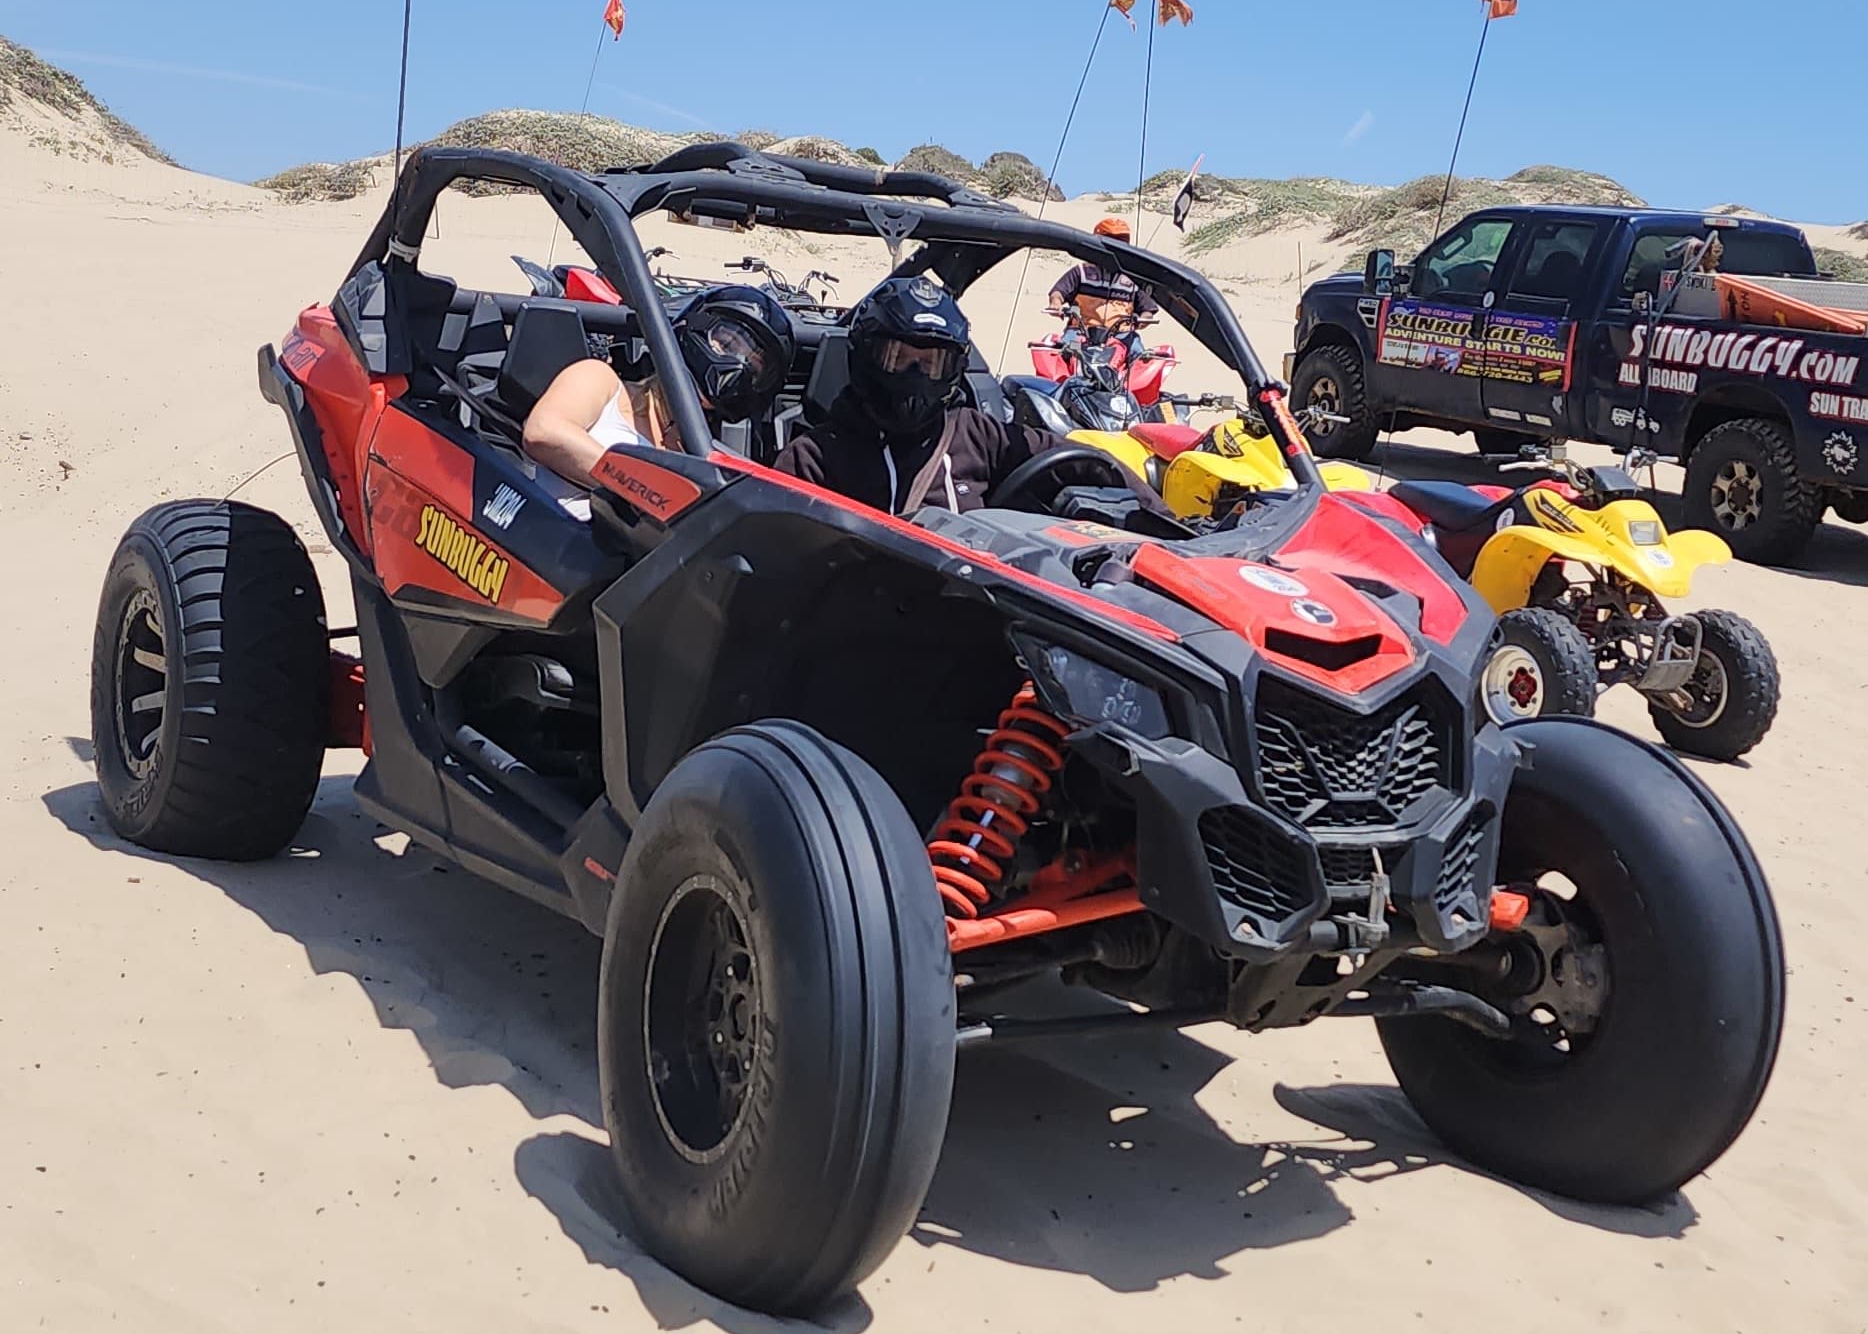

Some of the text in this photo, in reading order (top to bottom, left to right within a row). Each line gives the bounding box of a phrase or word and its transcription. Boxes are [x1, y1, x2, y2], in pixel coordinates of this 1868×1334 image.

[1384, 327, 1462, 348] ADVENTURE
[1465, 339, 1522, 356] STARTS
[1525, 346, 1566, 362] NOW!
[1629, 324, 1859, 385] SUNBUGGY.COM
[1618, 362, 1641, 385] ALL
[1810, 391, 1841, 416] SUN
[602, 461, 672, 511] MAVERICK
[415, 505, 509, 604] SUNBUGGY
